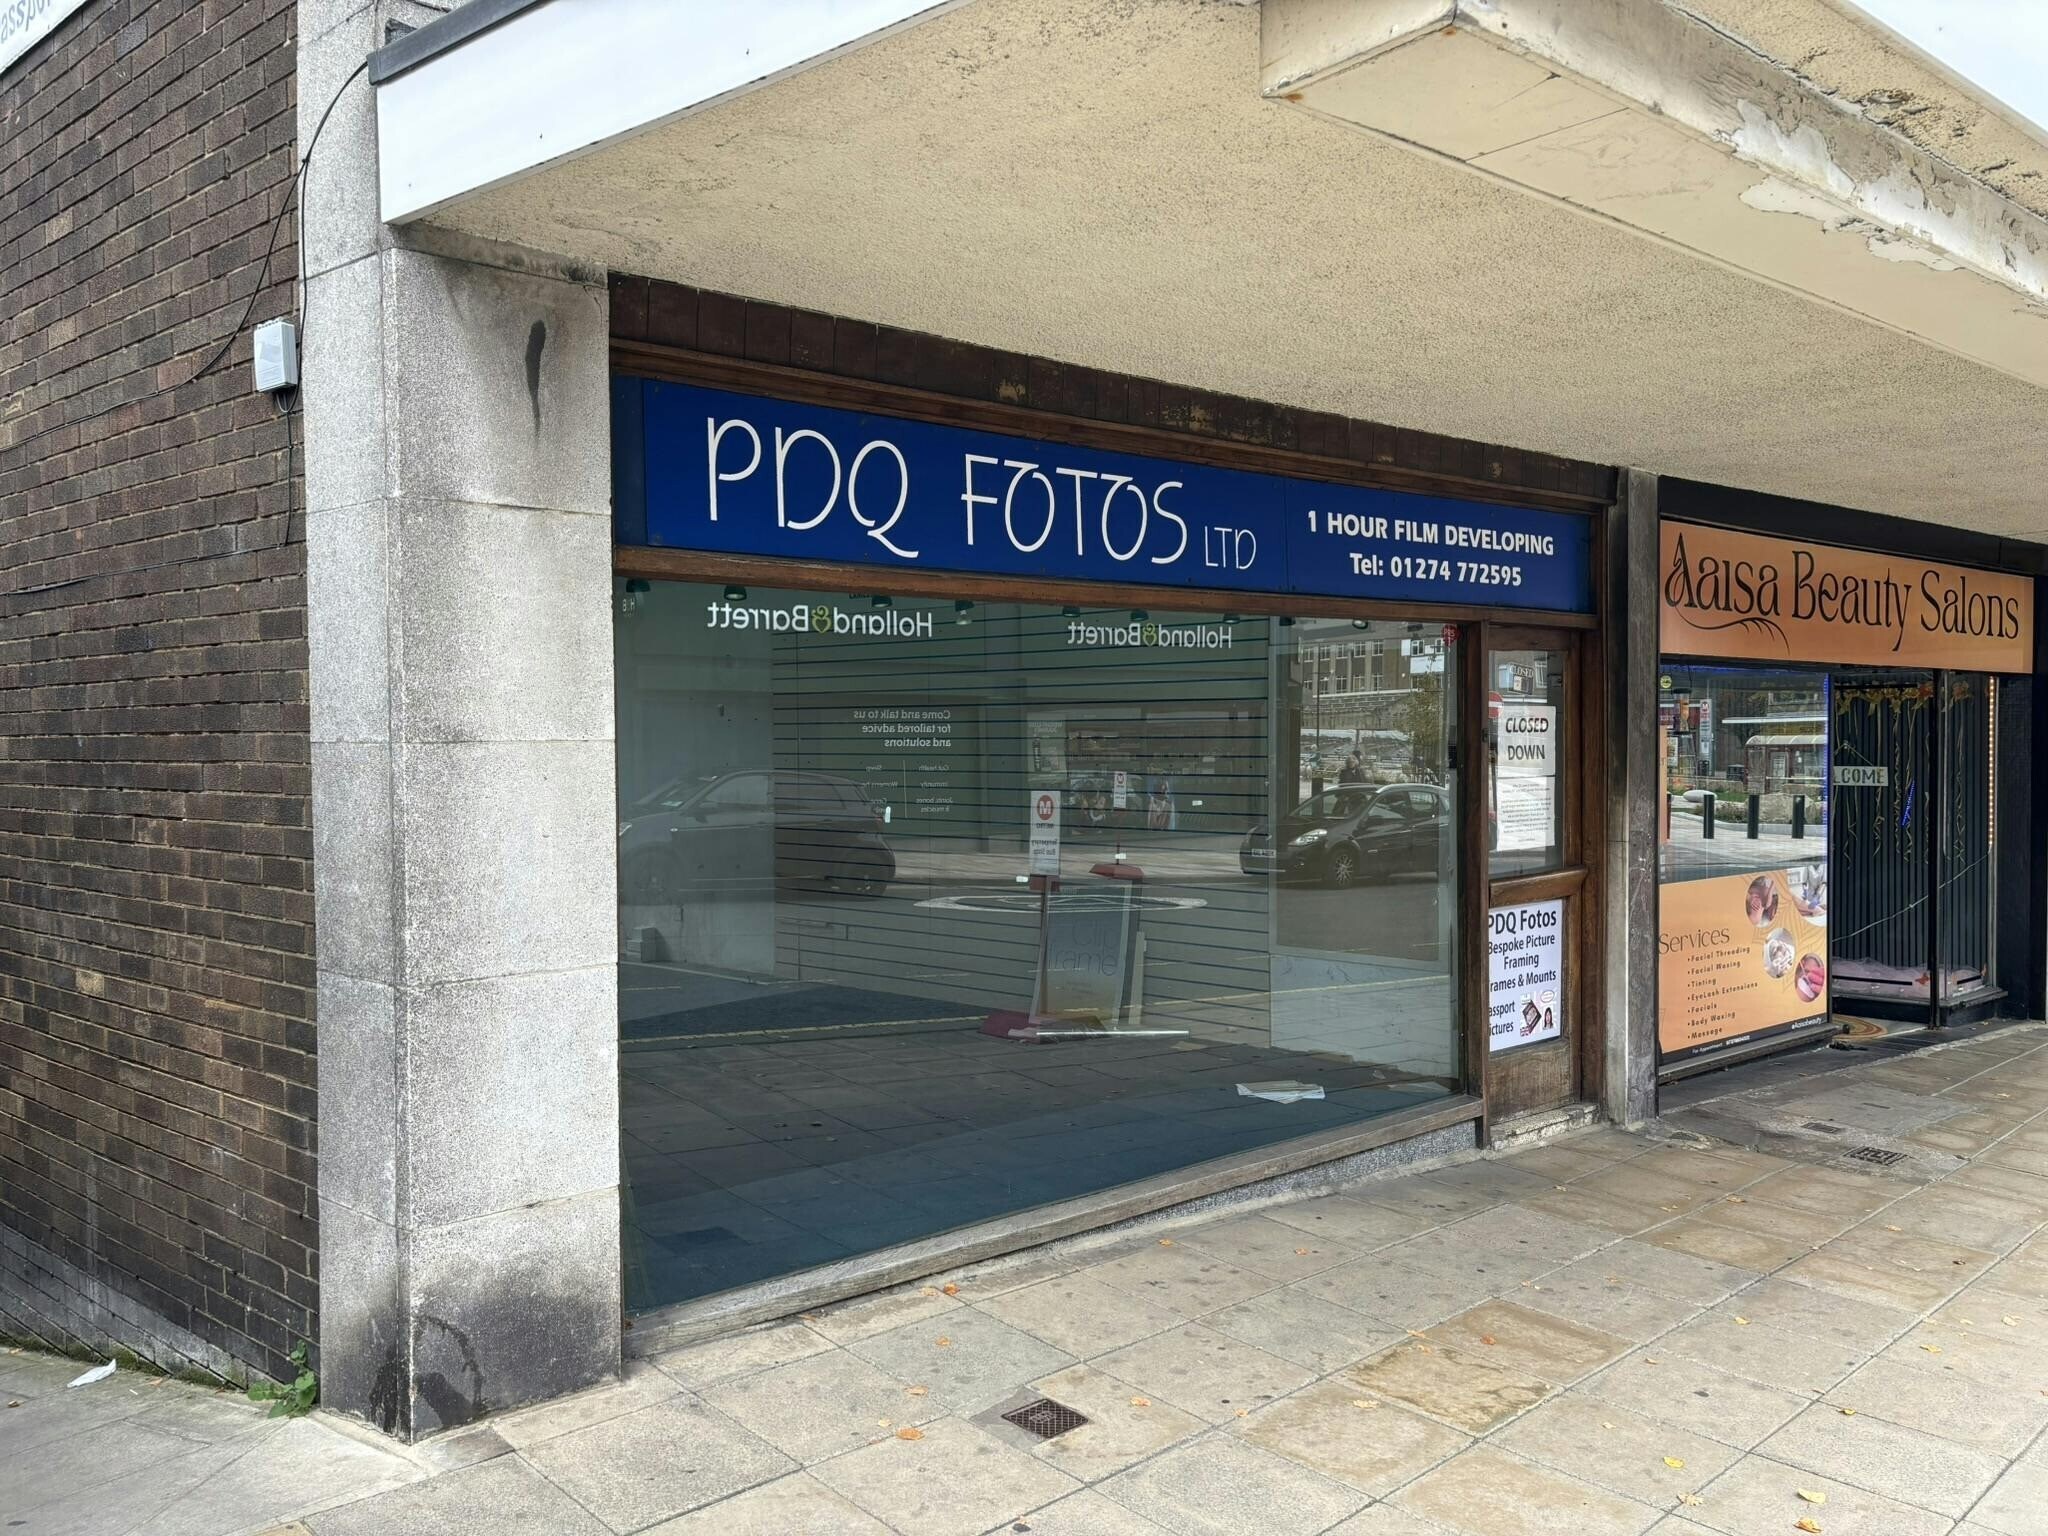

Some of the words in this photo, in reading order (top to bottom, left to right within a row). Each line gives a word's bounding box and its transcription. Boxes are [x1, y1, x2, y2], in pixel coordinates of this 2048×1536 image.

[707, 416, 919, 559] PDQ
[961, 453, 1188, 566] FOTOS
[1204, 525, 1257, 571] LTD
[1308, 510, 1318, 533] 1
[1327, 512, 1388, 540] HOUR
[1394, 519, 1439, 545] FILM
[1445, 525, 1555, 556] DEVELOPING
[1350, 552, 1385, 577] Tel:
[1390, 556, 1451, 582] 01274
[1456, 562, 1523, 587] 772595
[1791, 549, 1913, 653] Beauty
[1920, 570, 2020, 640] Salons
[1509, 664, 1534, 679] CLOSED
[1505, 717, 1549, 734] CLOSED
[1507, 744, 1546, 761] DOWN
[1520, 909, 1558, 932] Fotos
[1488, 937, 1525, 957] Bespoke
[1526, 934, 1556, 949] Picture
[1659, 927, 1730, 955] Services
[1504, 953, 1540, 971] Framing
[1691, 952, 1714, 962] Facial
[1716, 947, 1751, 958] Threading
[1691, 964, 1714, 975] Facial
[1490, 977, 1517, 993] rames
[1518, 973, 1525, 988] &
[1526, 969, 1557, 986] Mounts
[1691, 979, 1717, 988] Tinting
[1489, 1000, 1516, 1018] assport
[1691, 1002, 1718, 1014] Facials
[1489, 1020, 1515, 1037] ictures
[1691, 1018, 1708, 1027] Body
[1691, 1027, 1723, 1040] Massage
